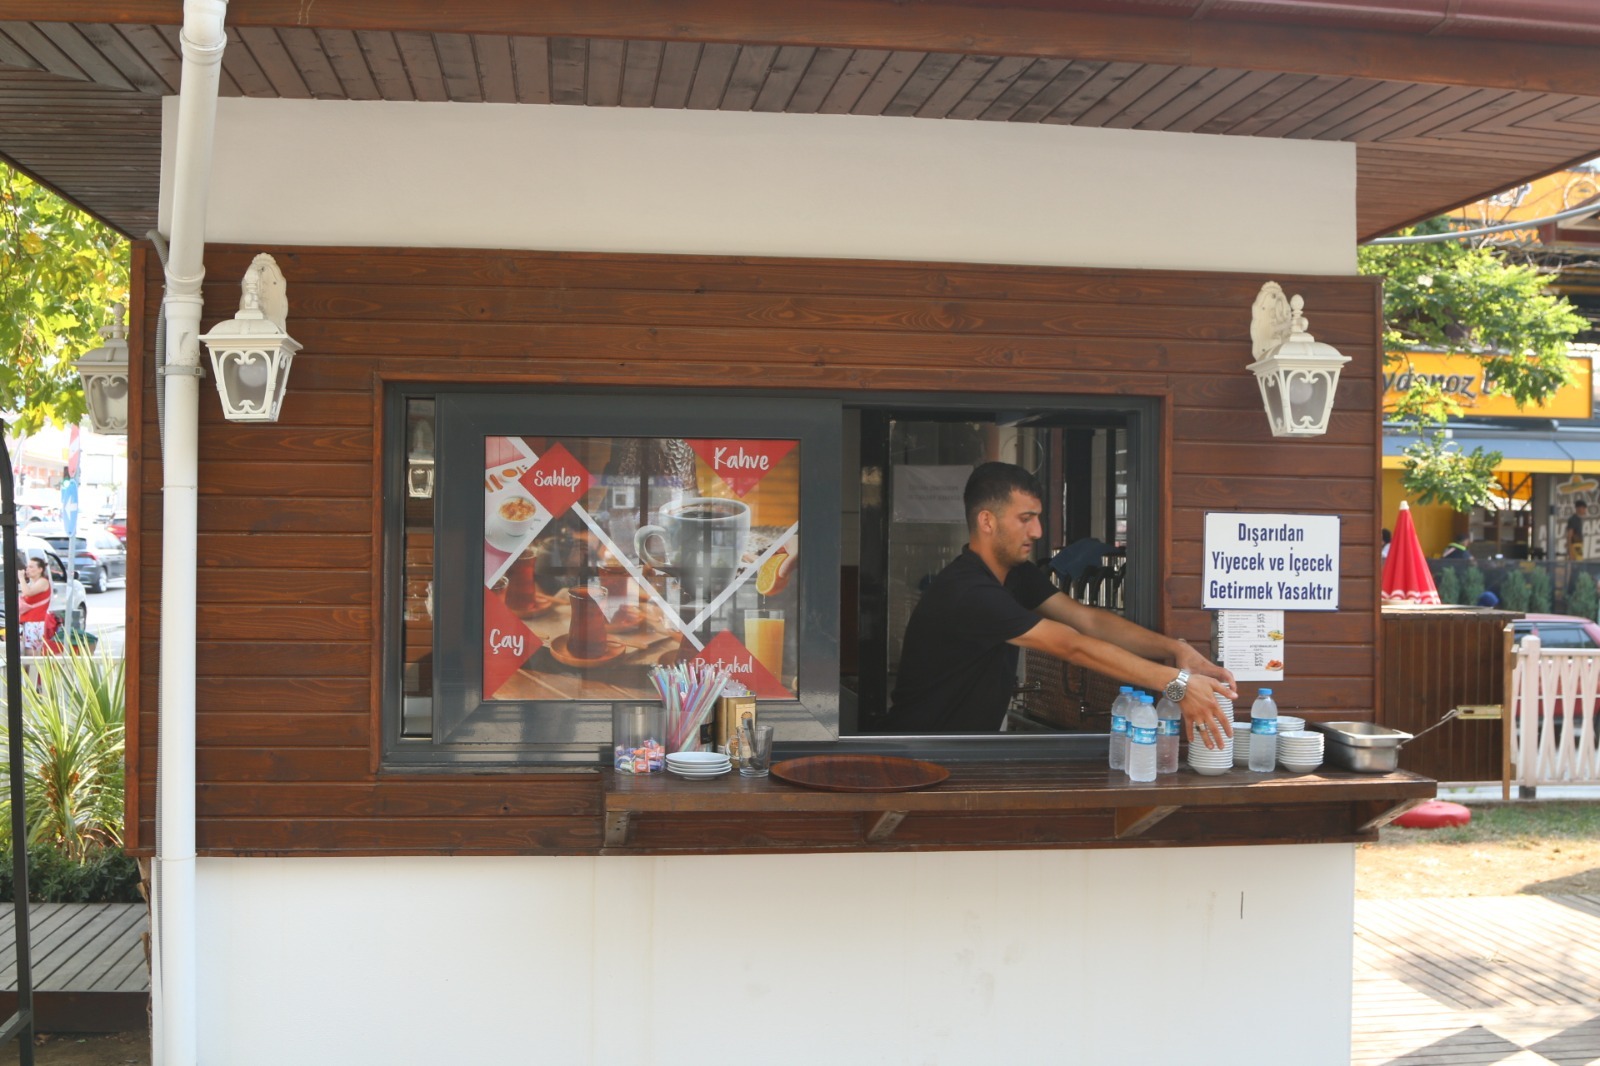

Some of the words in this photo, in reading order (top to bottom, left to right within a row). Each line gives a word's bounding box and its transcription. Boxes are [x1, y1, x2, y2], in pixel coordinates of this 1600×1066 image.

[714, 446, 769, 470] Kahve
[534, 467, 581, 493] Sahlep
[1238, 522, 1304, 547] Dışarıdan
[1212, 551, 1265, 574] Yiyecek
[1269, 557, 1284, 571] ve
[1289, 546, 1333, 577] İçecek
[1210, 580, 1273, 599] Getirmek
[1277, 581, 1333, 600] Yasaktır
[490, 628, 524, 657] Çay
